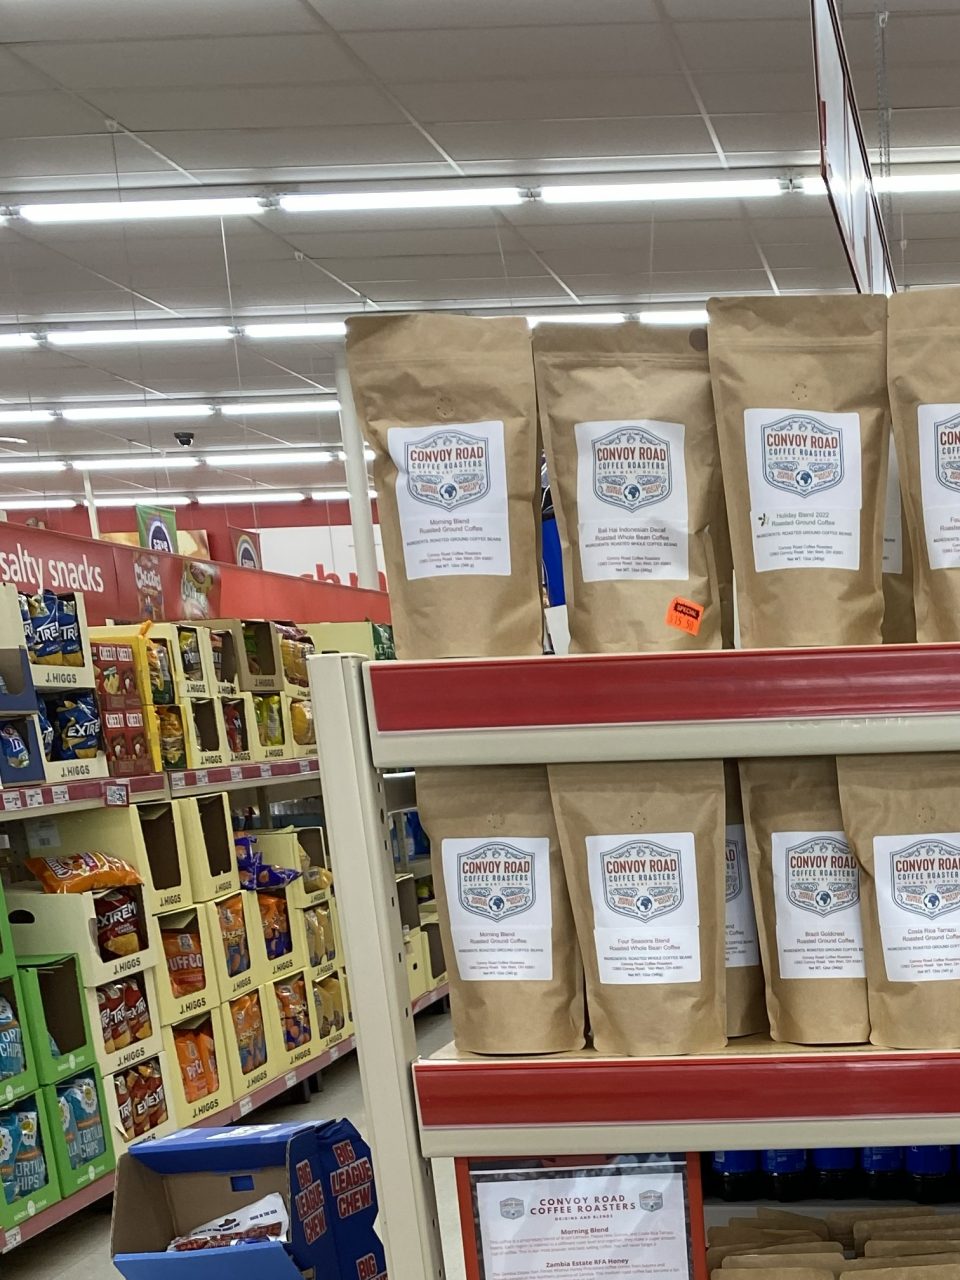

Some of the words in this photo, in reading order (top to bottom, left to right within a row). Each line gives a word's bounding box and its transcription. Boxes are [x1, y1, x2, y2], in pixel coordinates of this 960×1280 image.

[0, 542, 44, 594] salty
[49, 554, 104, 593] snacks
[45, 672, 77, 684] J.HIGGS
[60, 764, 90, 778] J.HIGGS
[462, 861, 501, 874] CONVOY
[504, 860, 530, 874] ROAD
[463, 874, 490, 882] COFFEE
[492, 874, 529, 882] ROASTERS
[113, 956, 141, 976] J.HIGGS
[179, 996, 207, 1016] J.HIGGS
[117, 1046, 145, 1068] J.HIGGS
[332, 1142, 354, 1166] BIG
[330, 1157, 374, 1196] LEAGUE
[337, 1184, 373, 1219] CHEW
[540, 1196, 588, 1206] CONVOY
[594, 1194, 626, 1203] ROAD
[530, 1206, 572, 1216] COFFEE
[577, 1202, 636, 1212] ROASTERS
[560, 1228, 589, 1236] Morning
[590, 1226, 609, 1234] Blend
[356, 1253, 377, 1280] BIG
[572, 1260, 594, 1268] Estate
[608, 1258, 629, 1266] Honey
